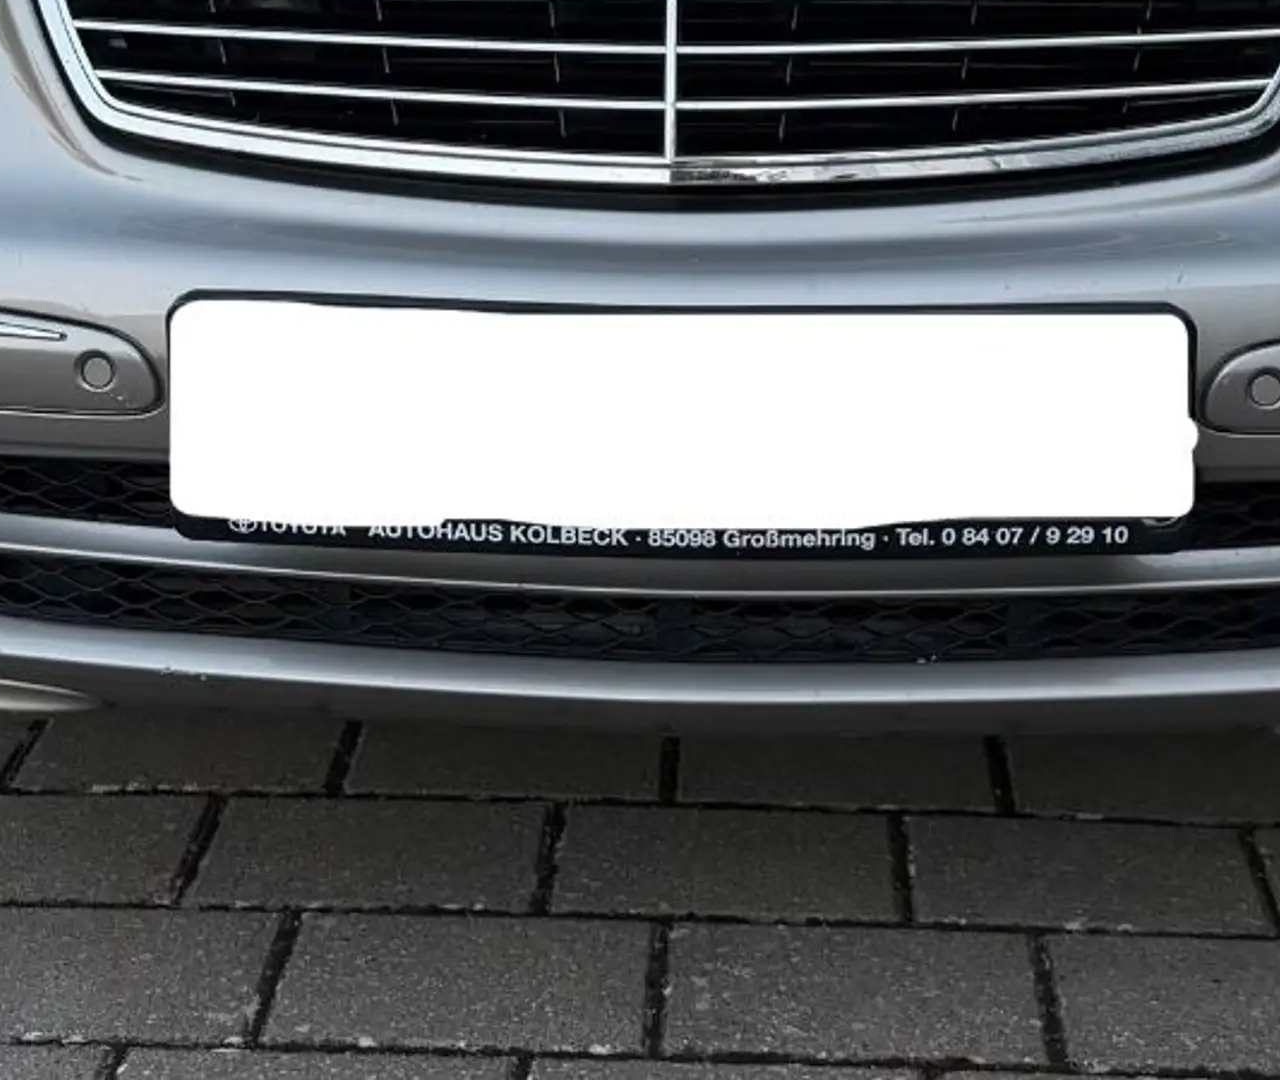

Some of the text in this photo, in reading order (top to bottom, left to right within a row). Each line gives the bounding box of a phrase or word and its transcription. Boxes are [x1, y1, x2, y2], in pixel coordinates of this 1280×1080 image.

[368, 522, 504, 542] AUTOHAUS
[509, 524, 629, 546] KOLBECK
[647, 529, 717, 547] 85098
[723, 529, 876, 551] Großmehring
[895, 527, 935, 546] Tel.
[941, 527, 956, 546] 0
[961, 527, 990, 545] 84
[994, 526, 1023, 546] 07
[1045, 526, 1061, 545] 9
[1066, 526, 1095, 545] 29
[1101, 526, 1129, 545] 10
